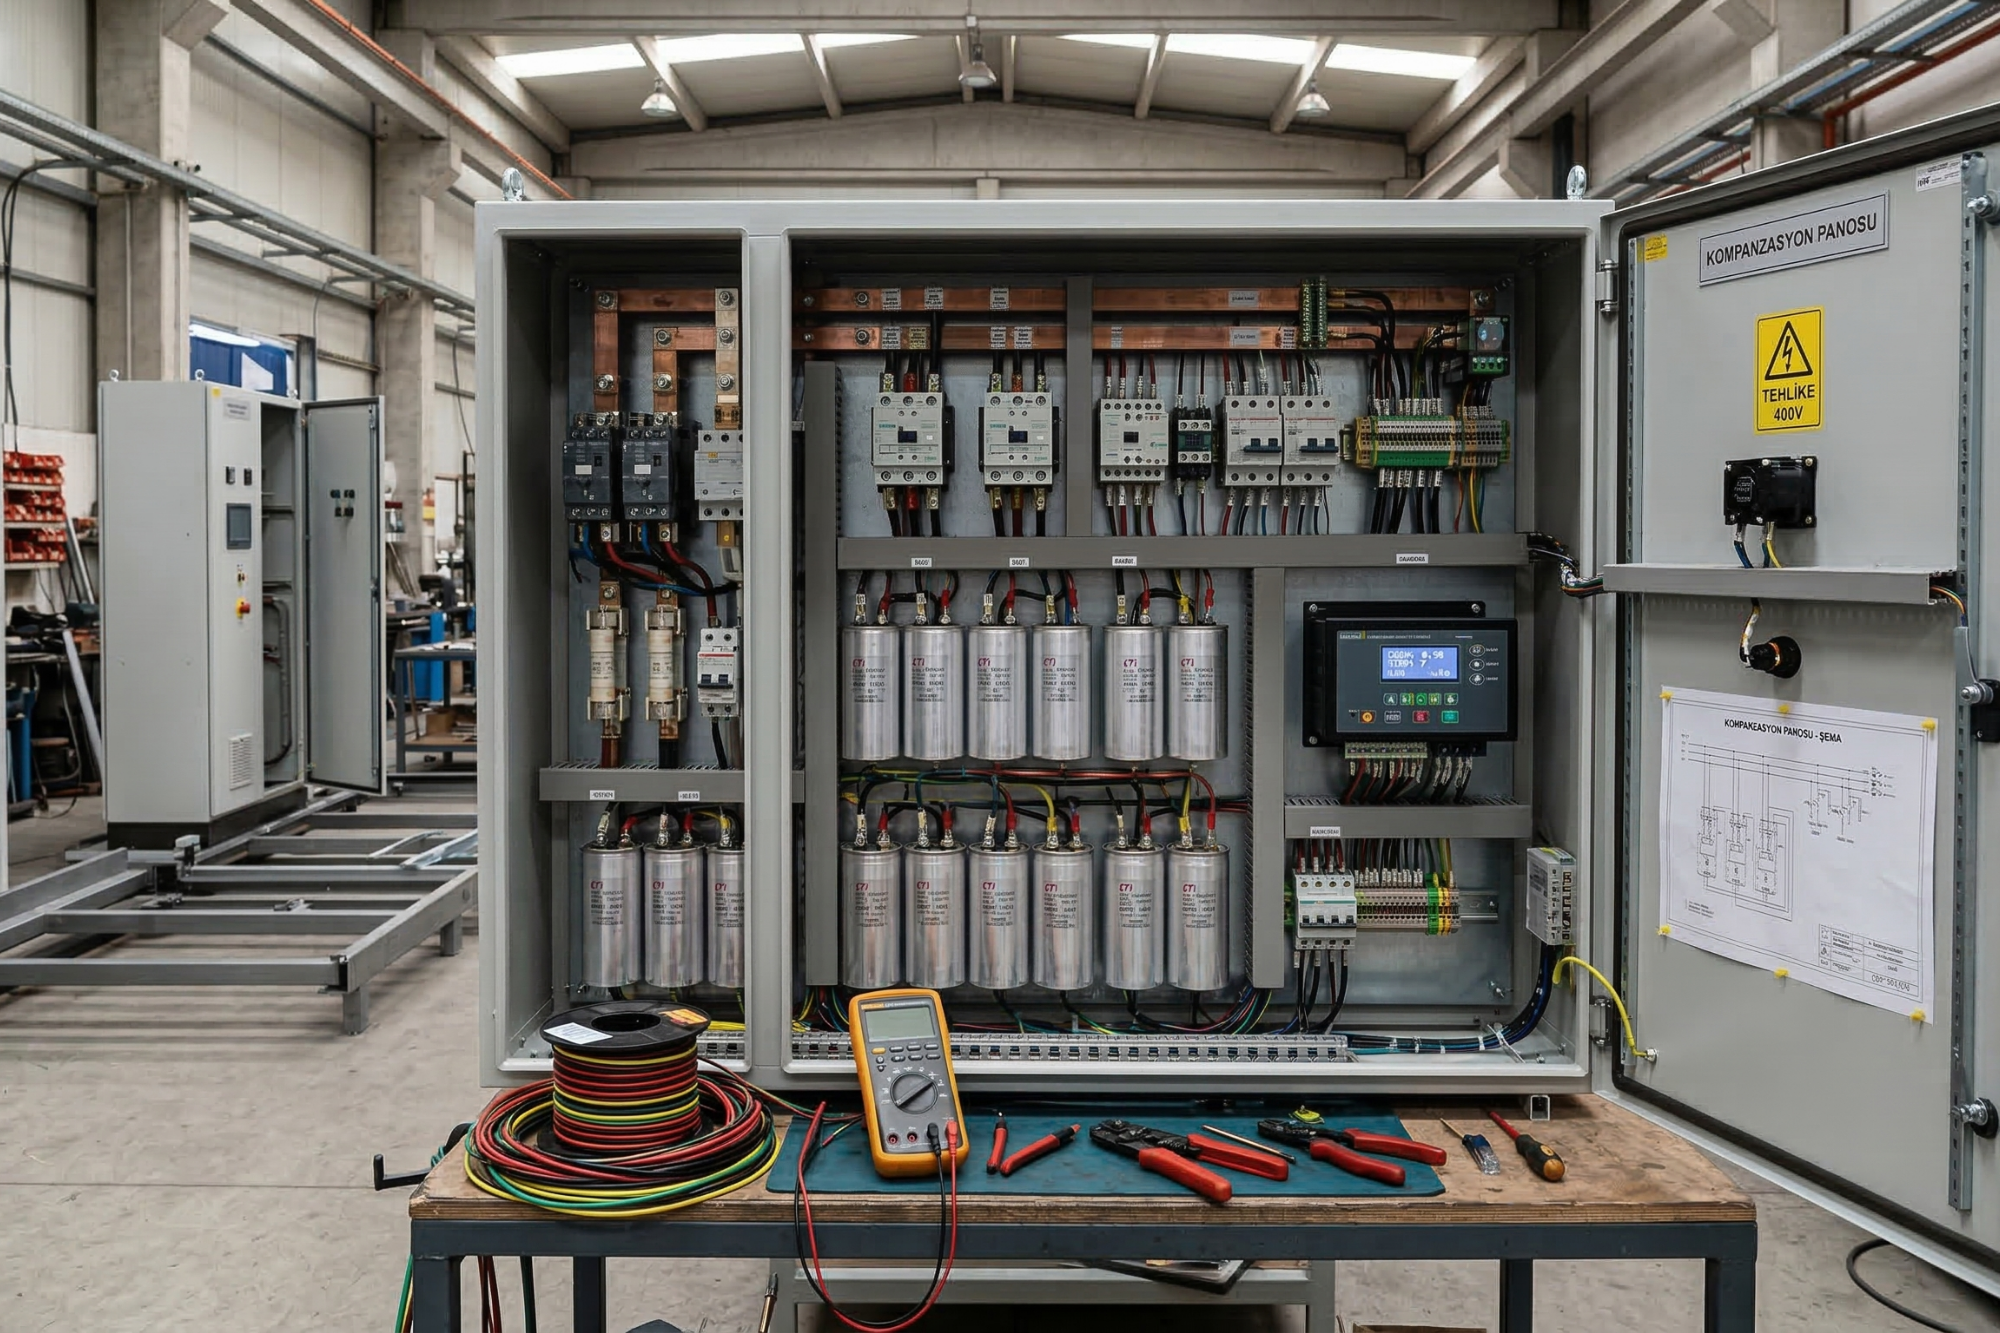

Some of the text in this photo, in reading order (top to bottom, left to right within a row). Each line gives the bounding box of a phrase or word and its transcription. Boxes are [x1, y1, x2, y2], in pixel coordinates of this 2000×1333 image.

[1706, 229, 1814, 267] KOMPANZASYON
[1817, 212, 1878, 245] PANOSU
[1762, 381, 1816, 403] TEHLİKE
[1773, 405, 1804, 422] 400V
[1783, 726, 1814, 739] PANOSU
